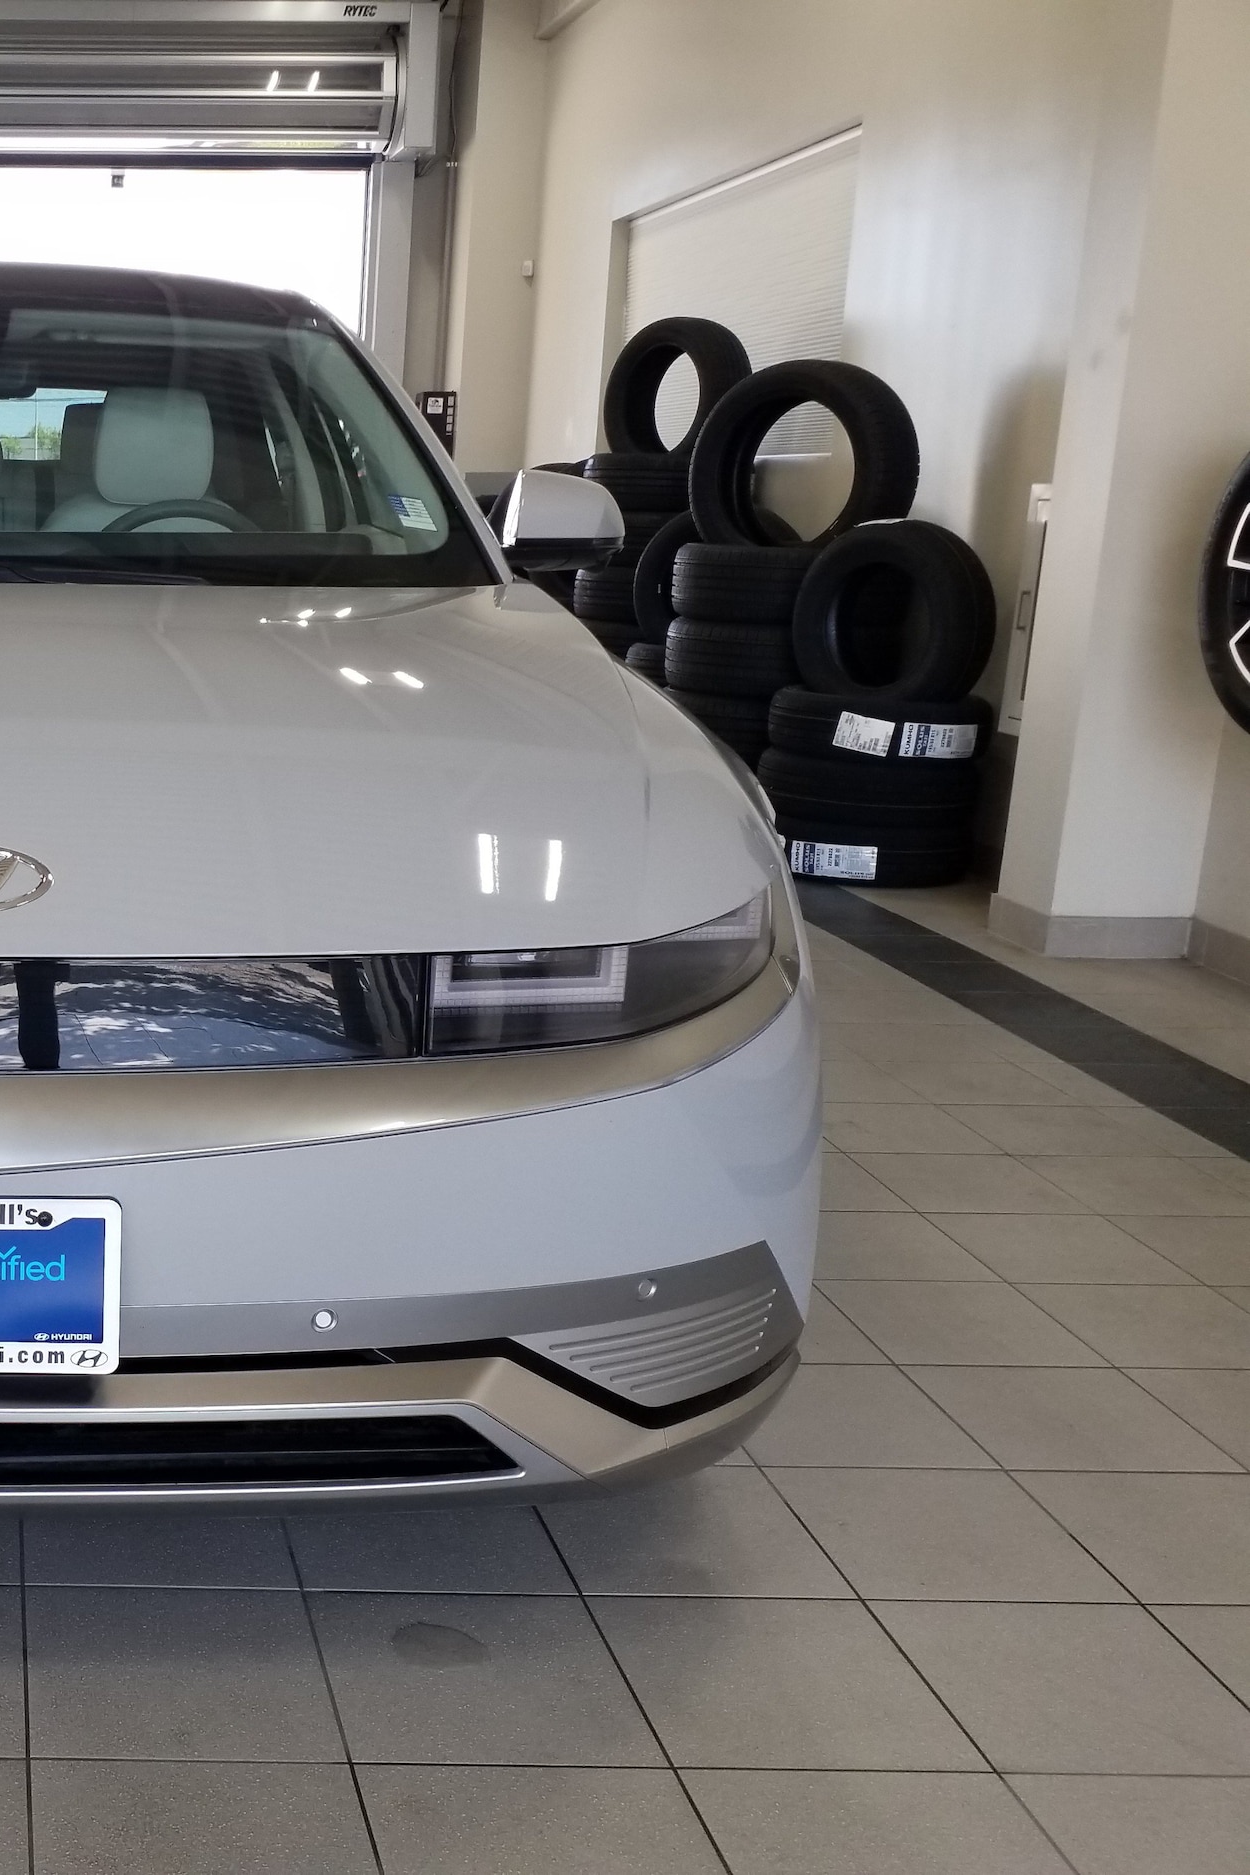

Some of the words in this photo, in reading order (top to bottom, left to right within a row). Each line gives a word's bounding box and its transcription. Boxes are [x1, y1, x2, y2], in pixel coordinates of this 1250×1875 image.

[343, 5, 378, 17] RYTEC
[904, 724, 914, 755] KUMHO
[51, 1333, 93, 1341] HYUNDAI
